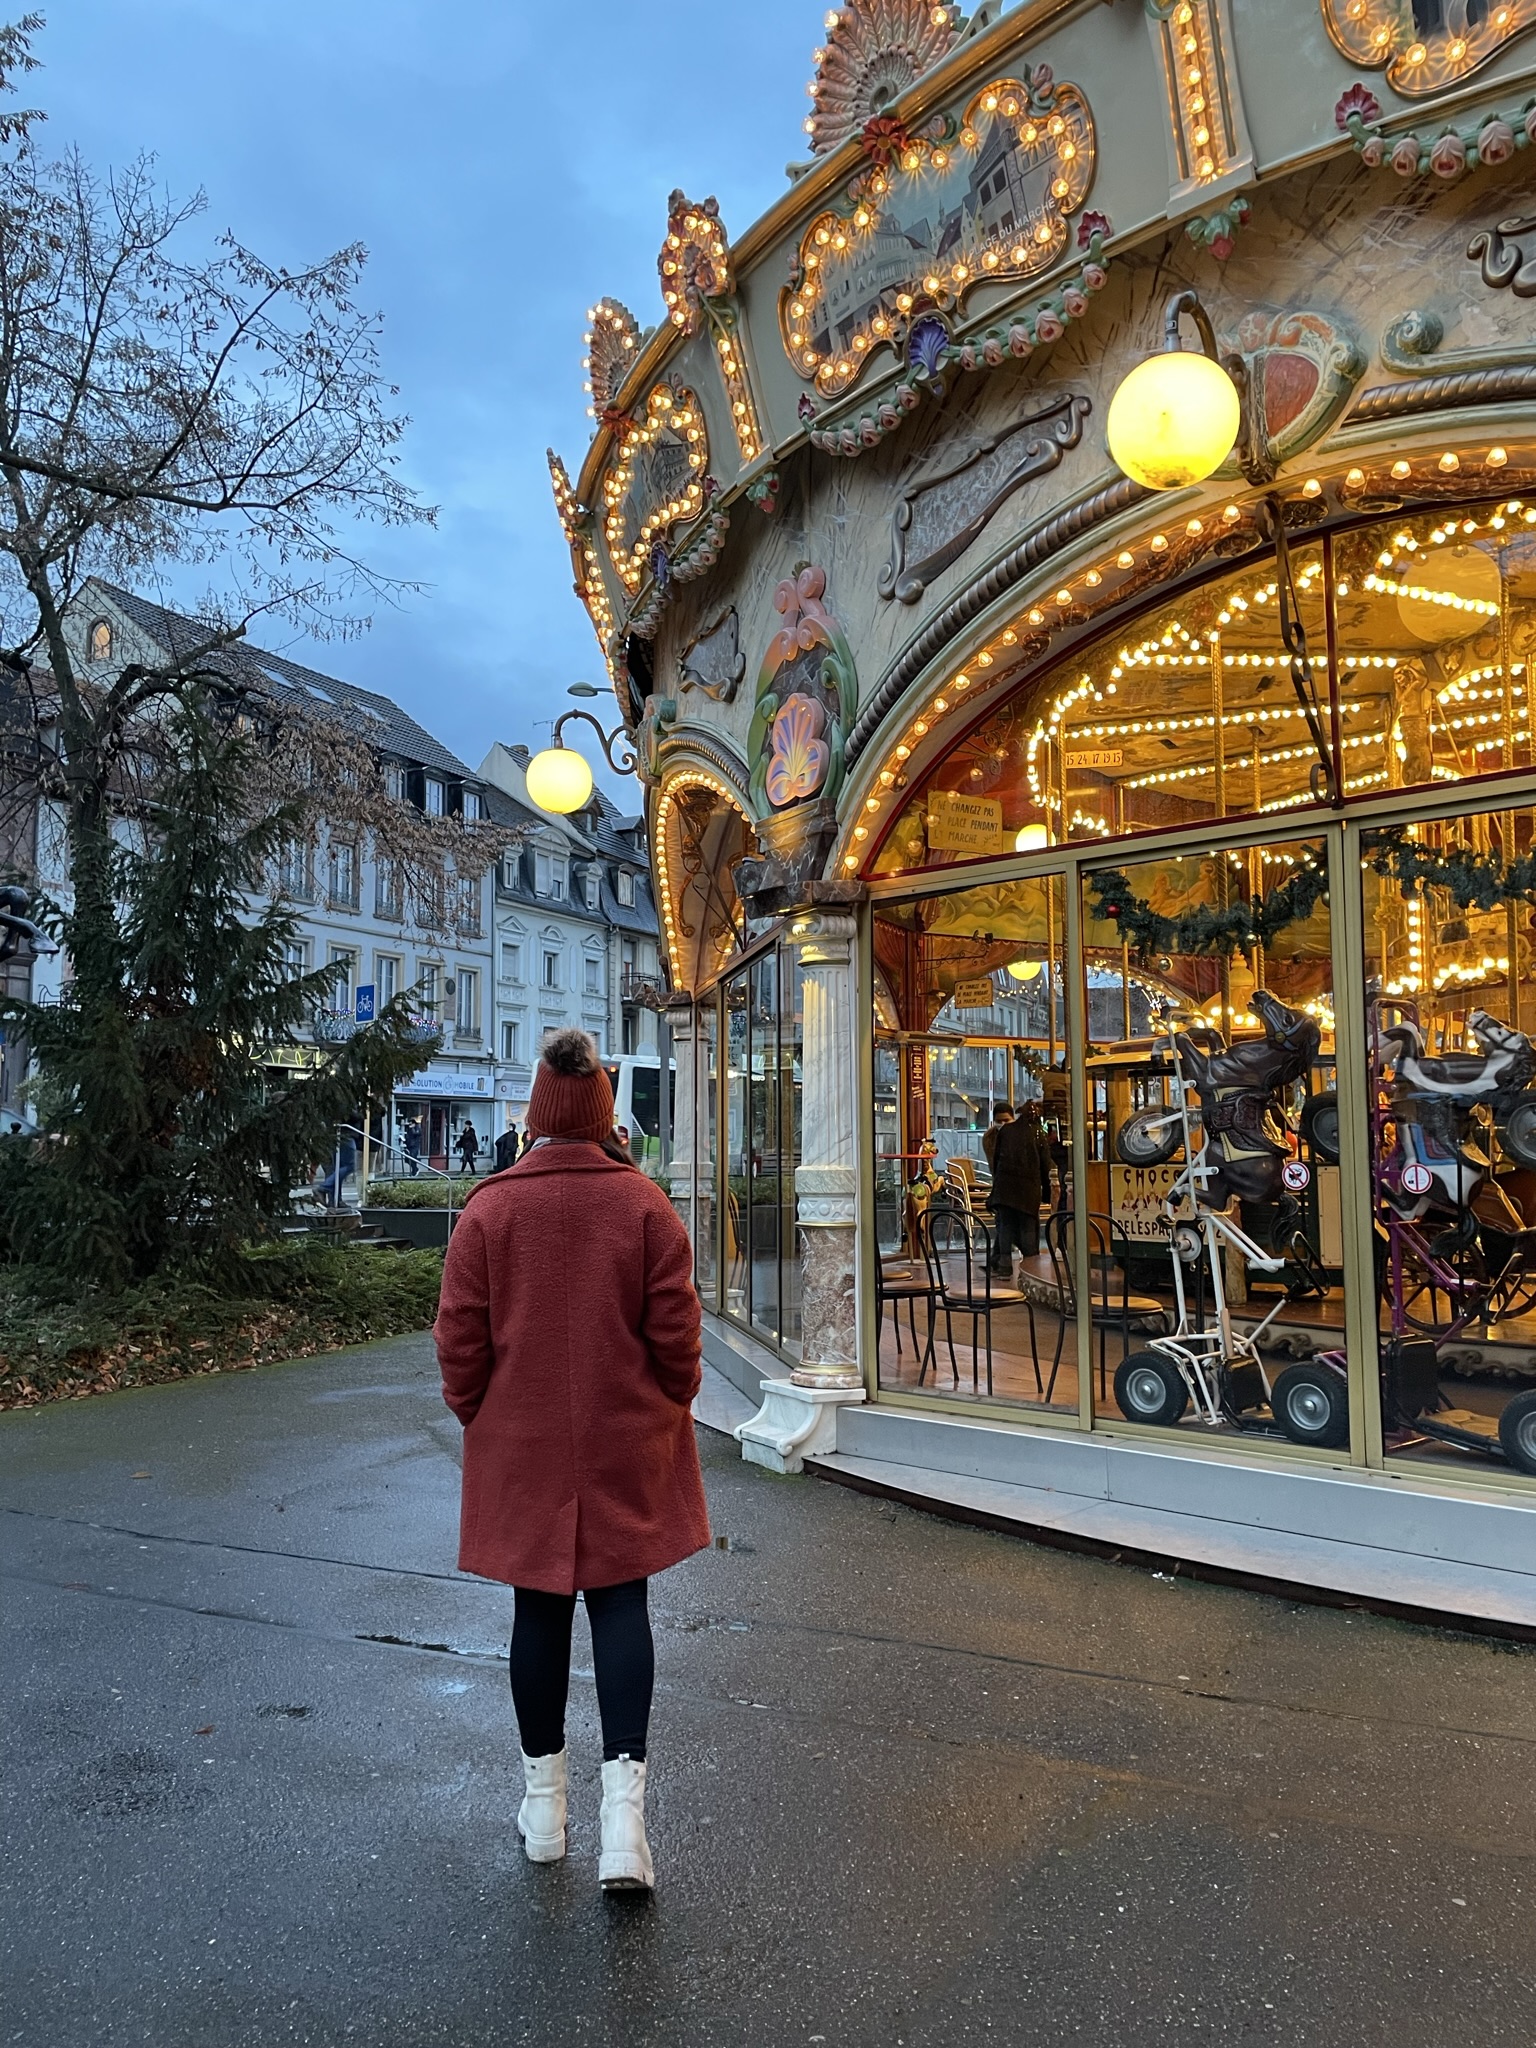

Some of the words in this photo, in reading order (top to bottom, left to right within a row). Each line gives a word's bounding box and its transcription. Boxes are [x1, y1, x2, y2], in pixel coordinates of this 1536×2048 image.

[968, 233, 997, 256] PLACE
[998, 223, 1013, 240] DU
[1013, 196, 1056, 230] MARCHÉ
[1066, 754, 1074, 766] 15
[951, 802, 981, 816] CHANGEZ
[983, 806, 994, 817] PAS
[947, 816, 967, 828] PLACE
[970, 819, 999, 833] PENDANT
[948, 831, 977, 844] MARCHE
